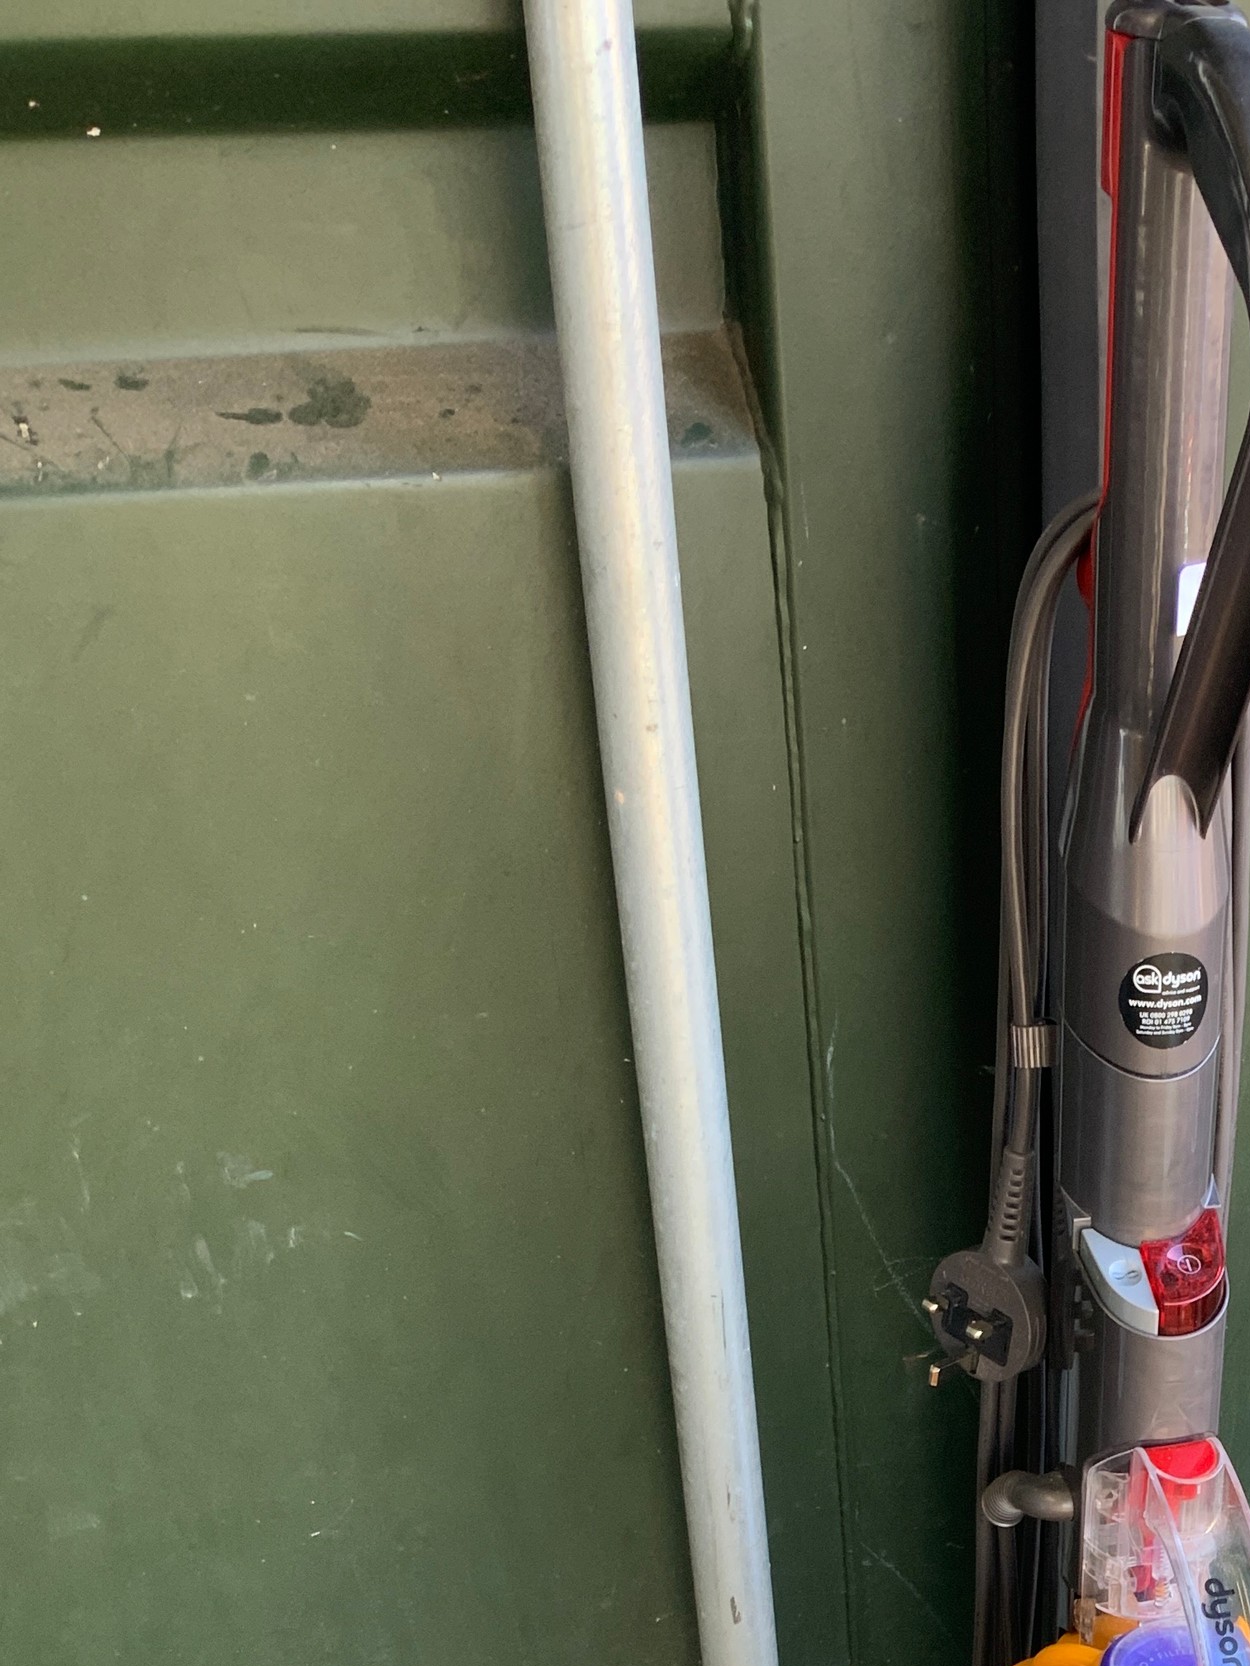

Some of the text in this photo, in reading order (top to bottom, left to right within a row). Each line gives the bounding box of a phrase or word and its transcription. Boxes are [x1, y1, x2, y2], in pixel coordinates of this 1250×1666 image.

[1136, 967, 1201, 988] ask dyson
[1128, 995, 1202, 1009] www.dyson.com
